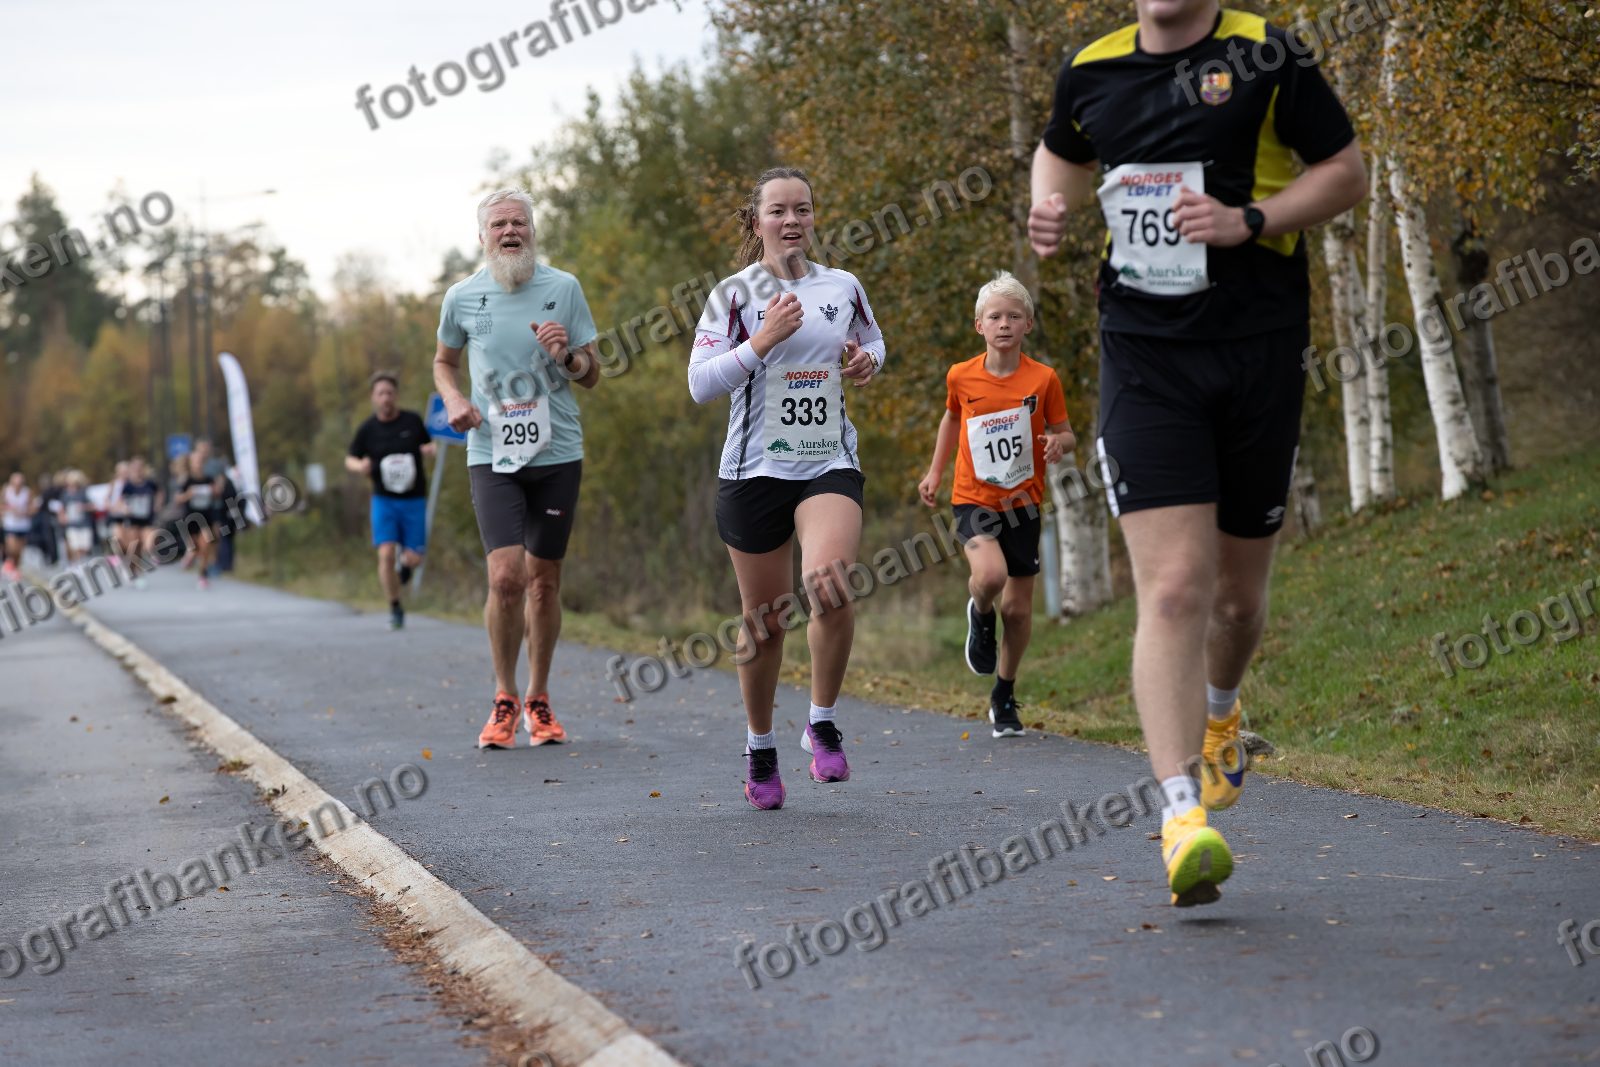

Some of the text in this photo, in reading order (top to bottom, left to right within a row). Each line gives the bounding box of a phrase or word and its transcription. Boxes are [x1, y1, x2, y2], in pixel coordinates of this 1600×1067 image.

[1120, 172, 1183, 185] NORGES
[1121, 208, 1181, 247] 769
[784, 370, 829, 381] NORGES
[788, 380, 823, 390] LØPET
[502, 401, 538, 411] NORGES
[780, 396, 828, 426] 333
[505, 409, 533, 418] LØPET
[981, 413, 1020, 429] NORGES
[502, 421, 539, 446] 299
[986, 422, 1015, 435] LØPET
[798, 439, 838, 450] Aurskog
[985, 435, 1023, 464] 105
[1004, 463, 1032, 481] Aurskog
